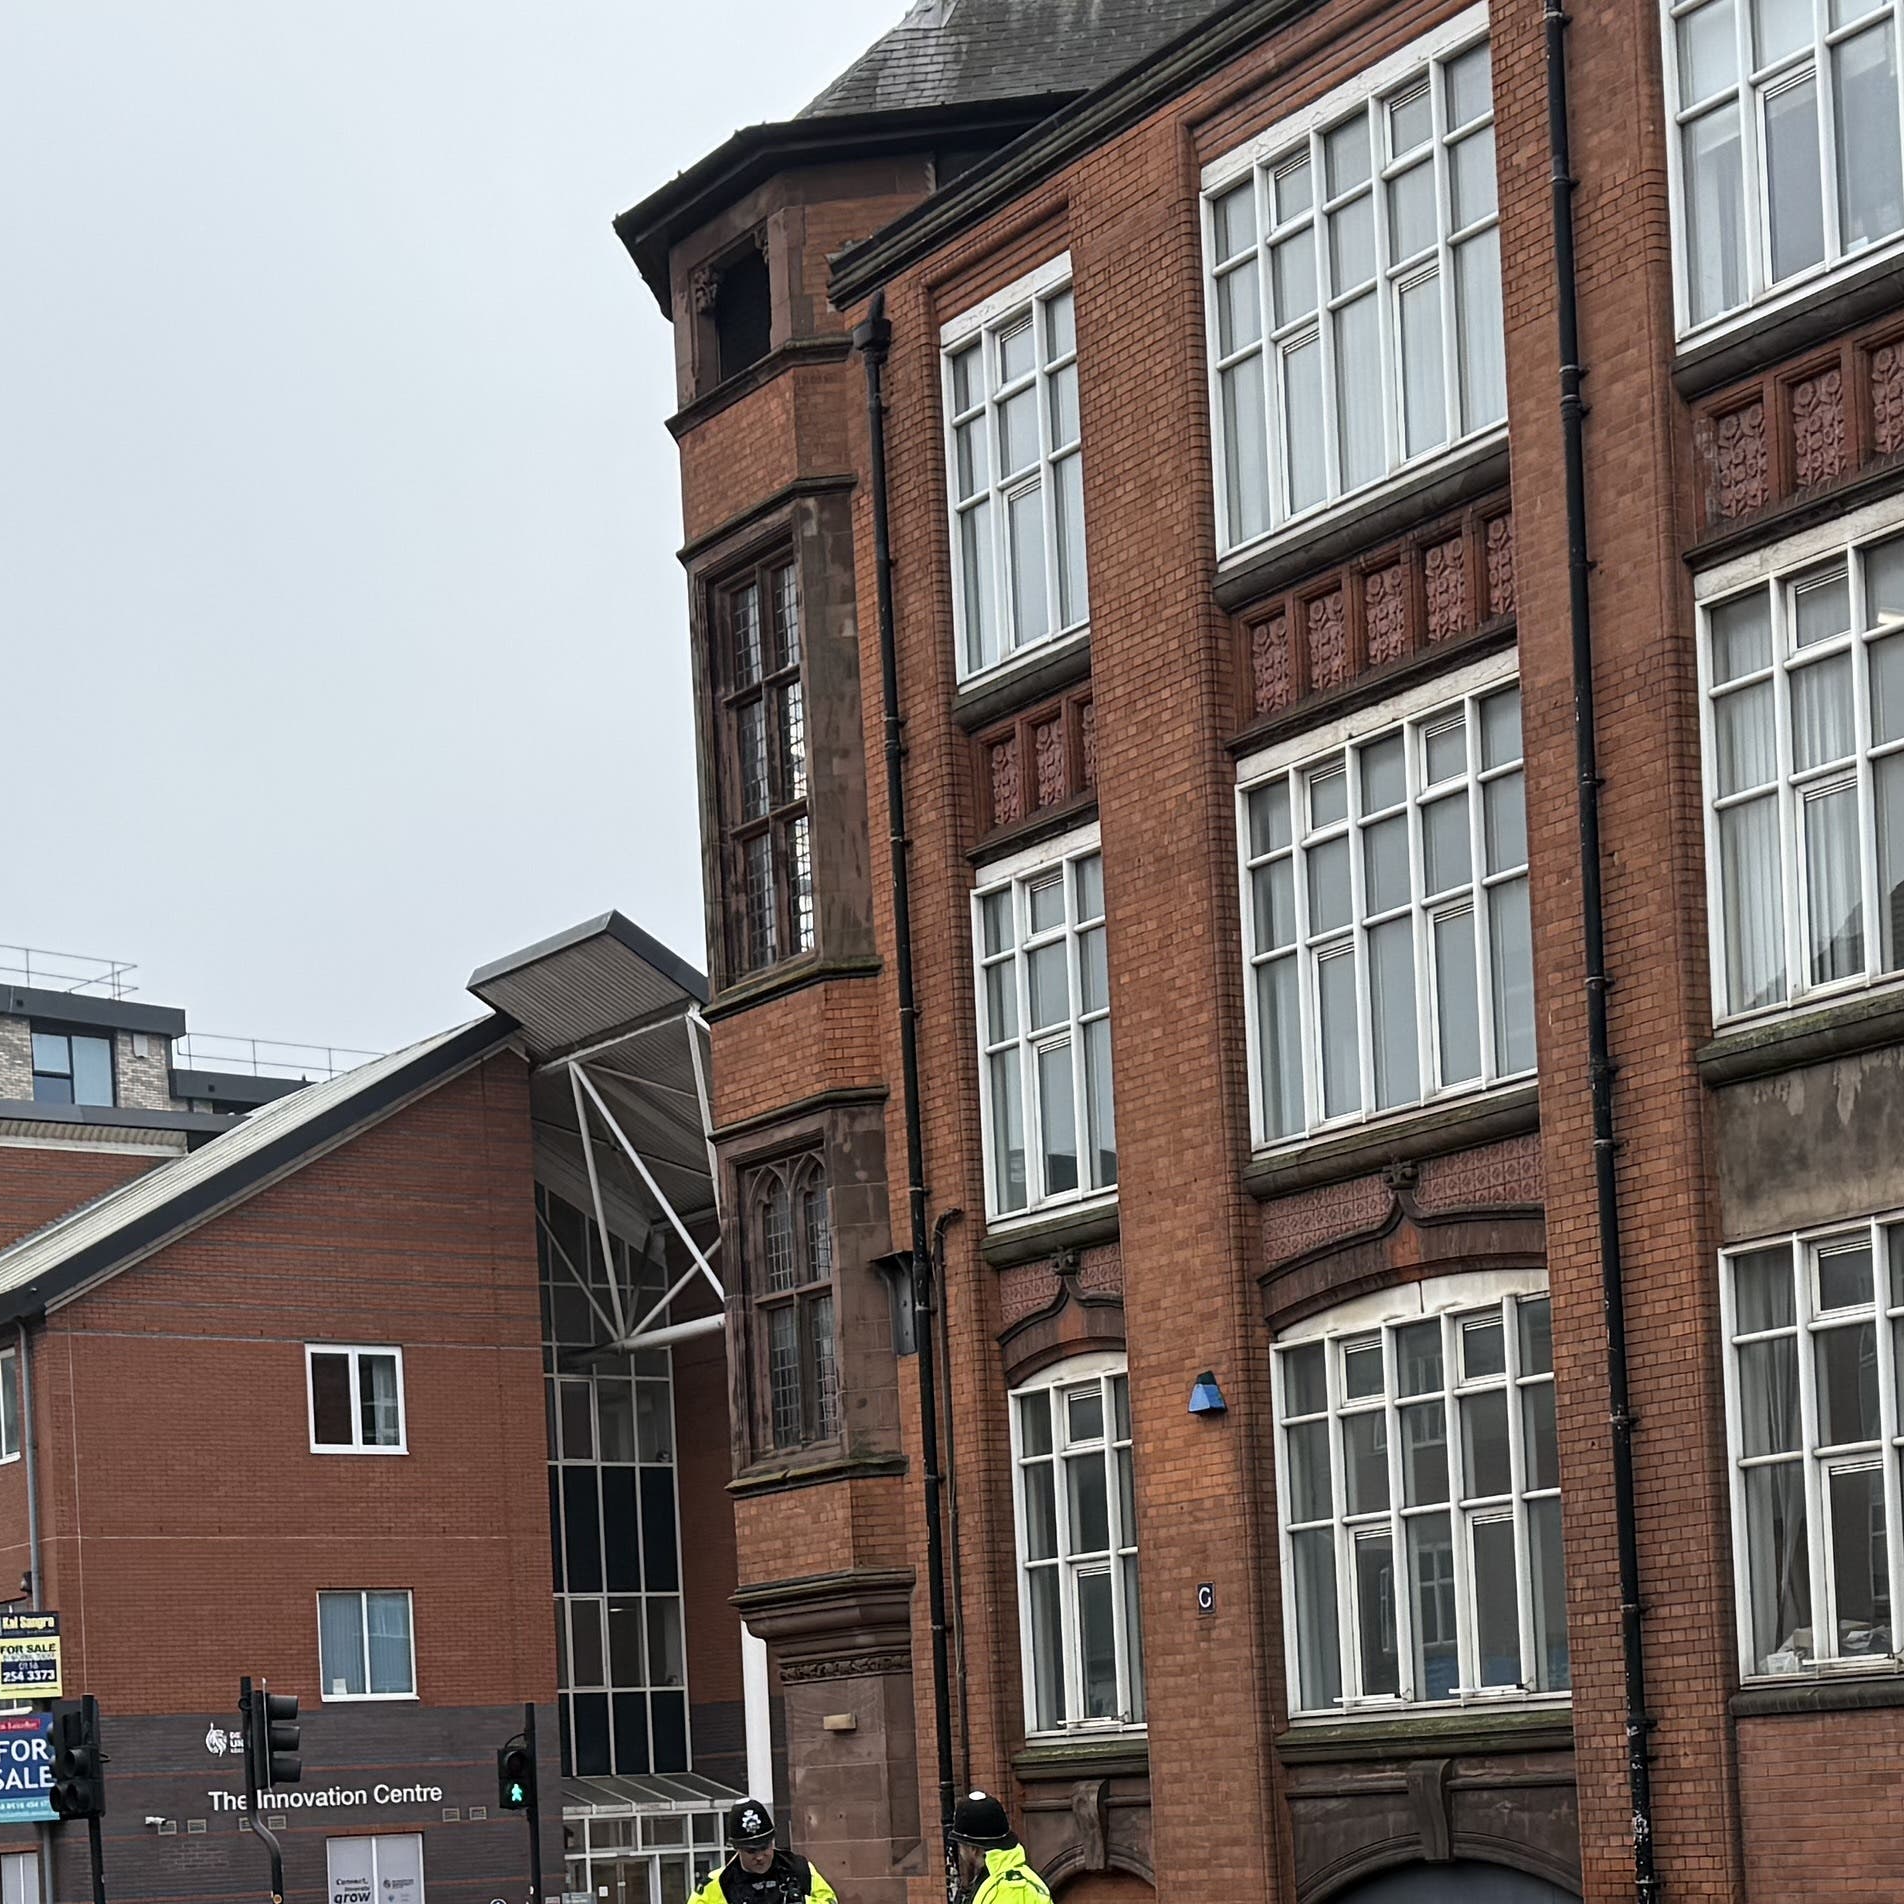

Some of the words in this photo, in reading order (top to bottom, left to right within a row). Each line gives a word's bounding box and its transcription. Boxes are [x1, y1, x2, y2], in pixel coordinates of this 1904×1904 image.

[0, 1645, 24, 1655] FOR
[26, 1643, 56, 1654] SALE
[208, 1790, 247, 1811] The
[256, 1785, 368, 1810] Innovation
[373, 1783, 443, 1805] Centre
